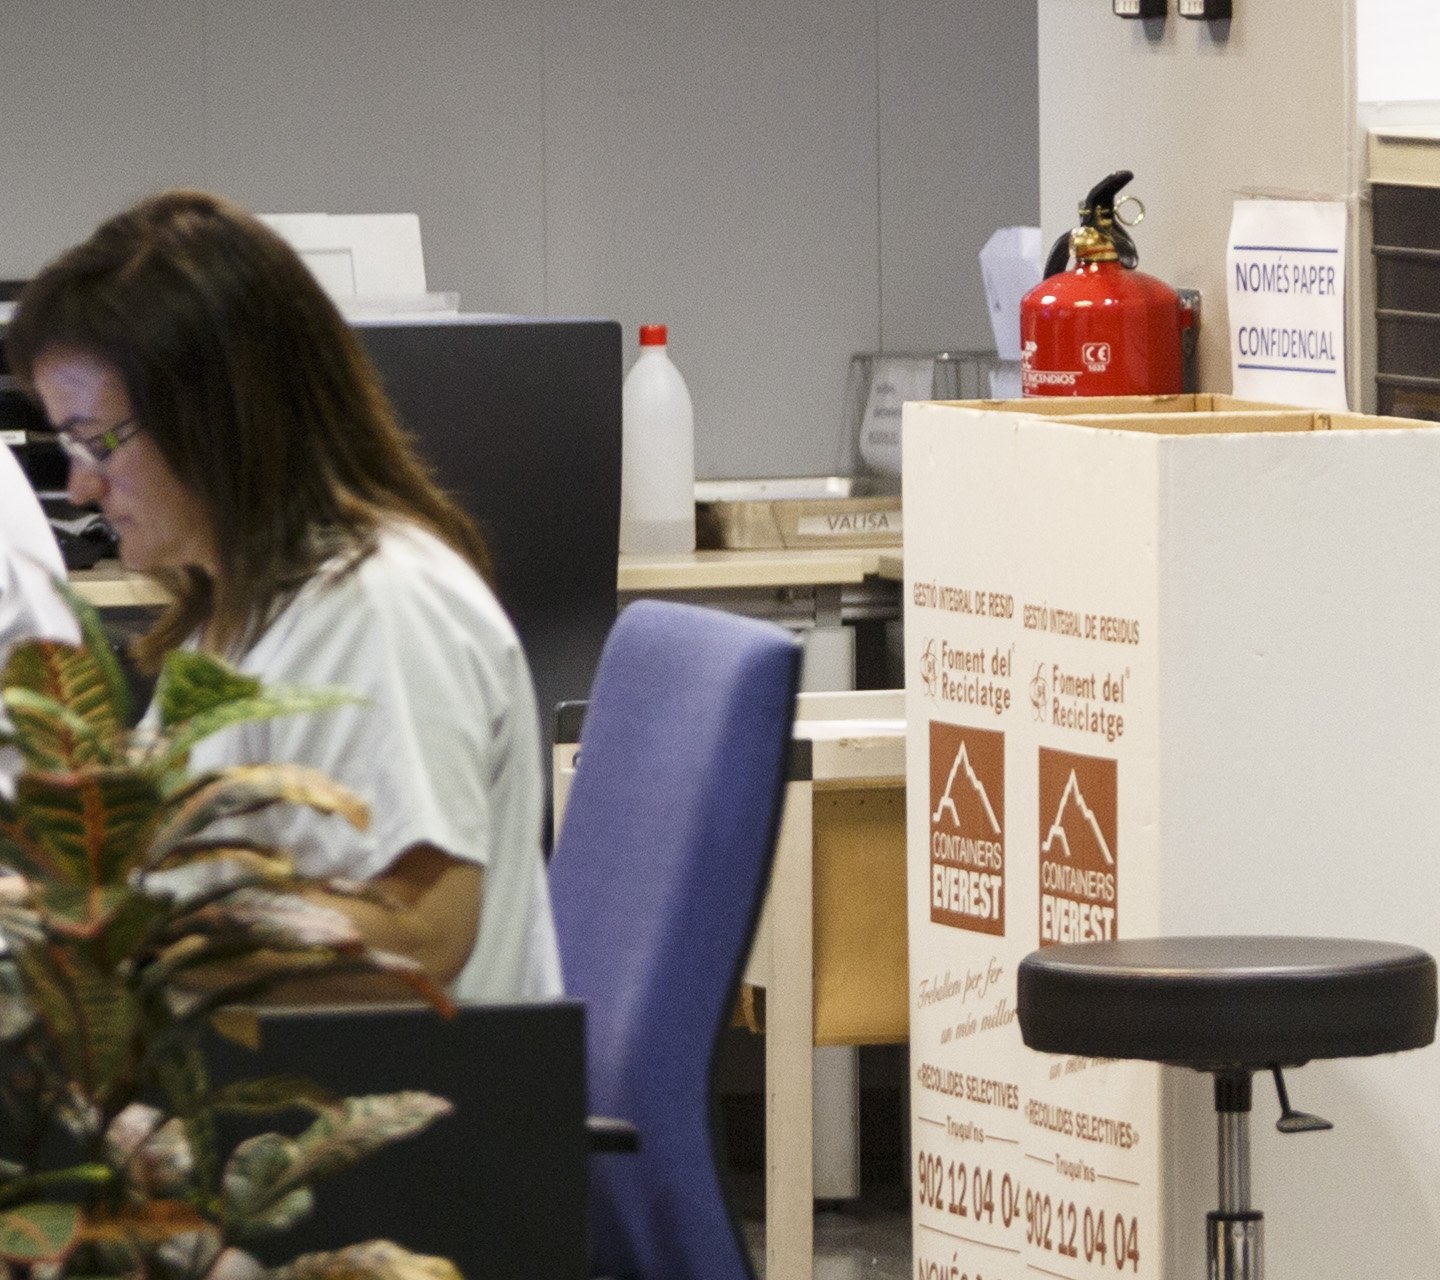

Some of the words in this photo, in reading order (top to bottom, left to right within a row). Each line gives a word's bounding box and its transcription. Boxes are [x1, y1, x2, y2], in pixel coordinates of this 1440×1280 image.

[1235, 255, 1290, 294] NOMÉS
[1293, 264, 1335, 296] PAPER
[1238, 326, 1336, 361] CONFIDENCIAL
[826, 512, 889, 531] VALISA
[914, 578, 938, 610] GESTIÓ
[939, 586, 974, 615] INTEGRAL
[975, 590, 987, 617] DE
[1023, 600, 1048, 632] GESTIÓ
[1050, 606, 1082, 638] INTEGRAL
[1085, 613, 1098, 641] DE
[1100, 614, 1140, 646] RESIDUS
[941, 640, 985, 674] Foment
[941, 672, 1011, 716] Reciclatge
[1052, 663, 1096, 701] Foment
[1052, 696, 1124, 743] Reciclatge
[932, 831, 1002, 870] CONTAINERS
[932, 863, 1002, 920] EVEREST
[1041, 860, 1115, 902] CONTAINERS
[1041, 893, 1115, 943] EVEREST
[966, 1075, 1019, 1111] SELECTIVES
[918, 1149, 944, 1211] 902
[948, 1160, 968, 1218] 12
[973, 1166, 995, 1225] 04
[1025, 1187, 1053, 1251] 902
[1058, 1199, 1078, 1259] 12
[1083, 1205, 1107, 1266] 04
[1113, 1212, 1140, 1274] 04
